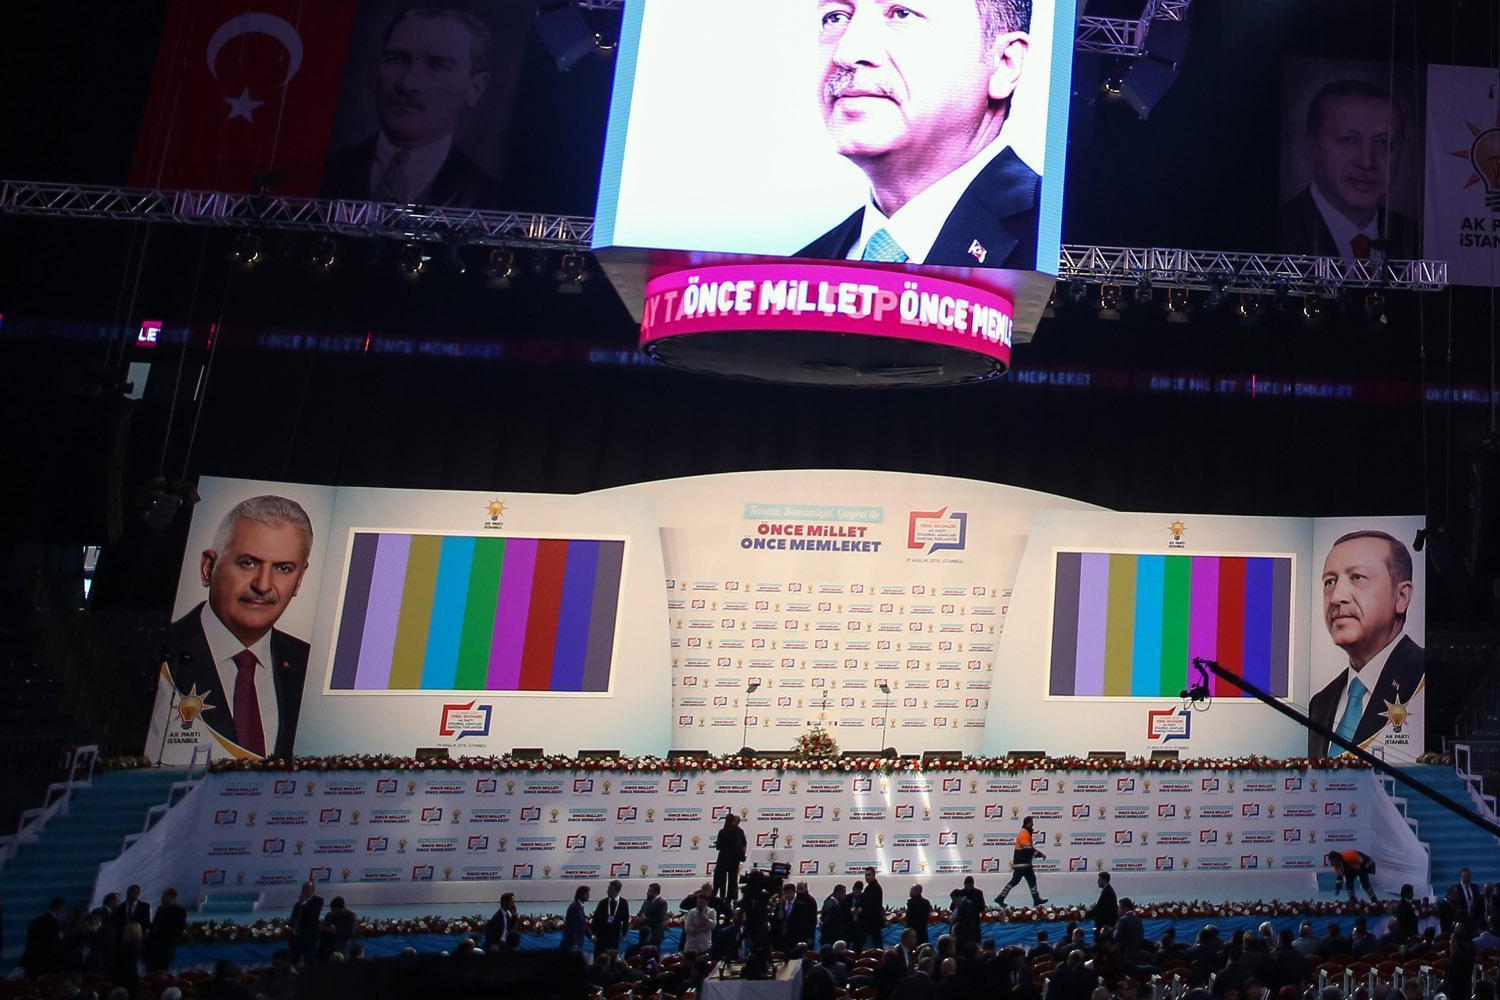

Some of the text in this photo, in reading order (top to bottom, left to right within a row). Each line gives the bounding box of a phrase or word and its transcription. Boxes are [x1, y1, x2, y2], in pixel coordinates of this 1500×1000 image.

[1460, 217, 1485, 231] AK
[683, 275, 755, 316] ÖNCE
[900, 281, 969, 330] ÖNCE
[757, 521, 804, 535] ÖNCE
[741, 535, 882, 552] ÖNCE MEMLEKET
